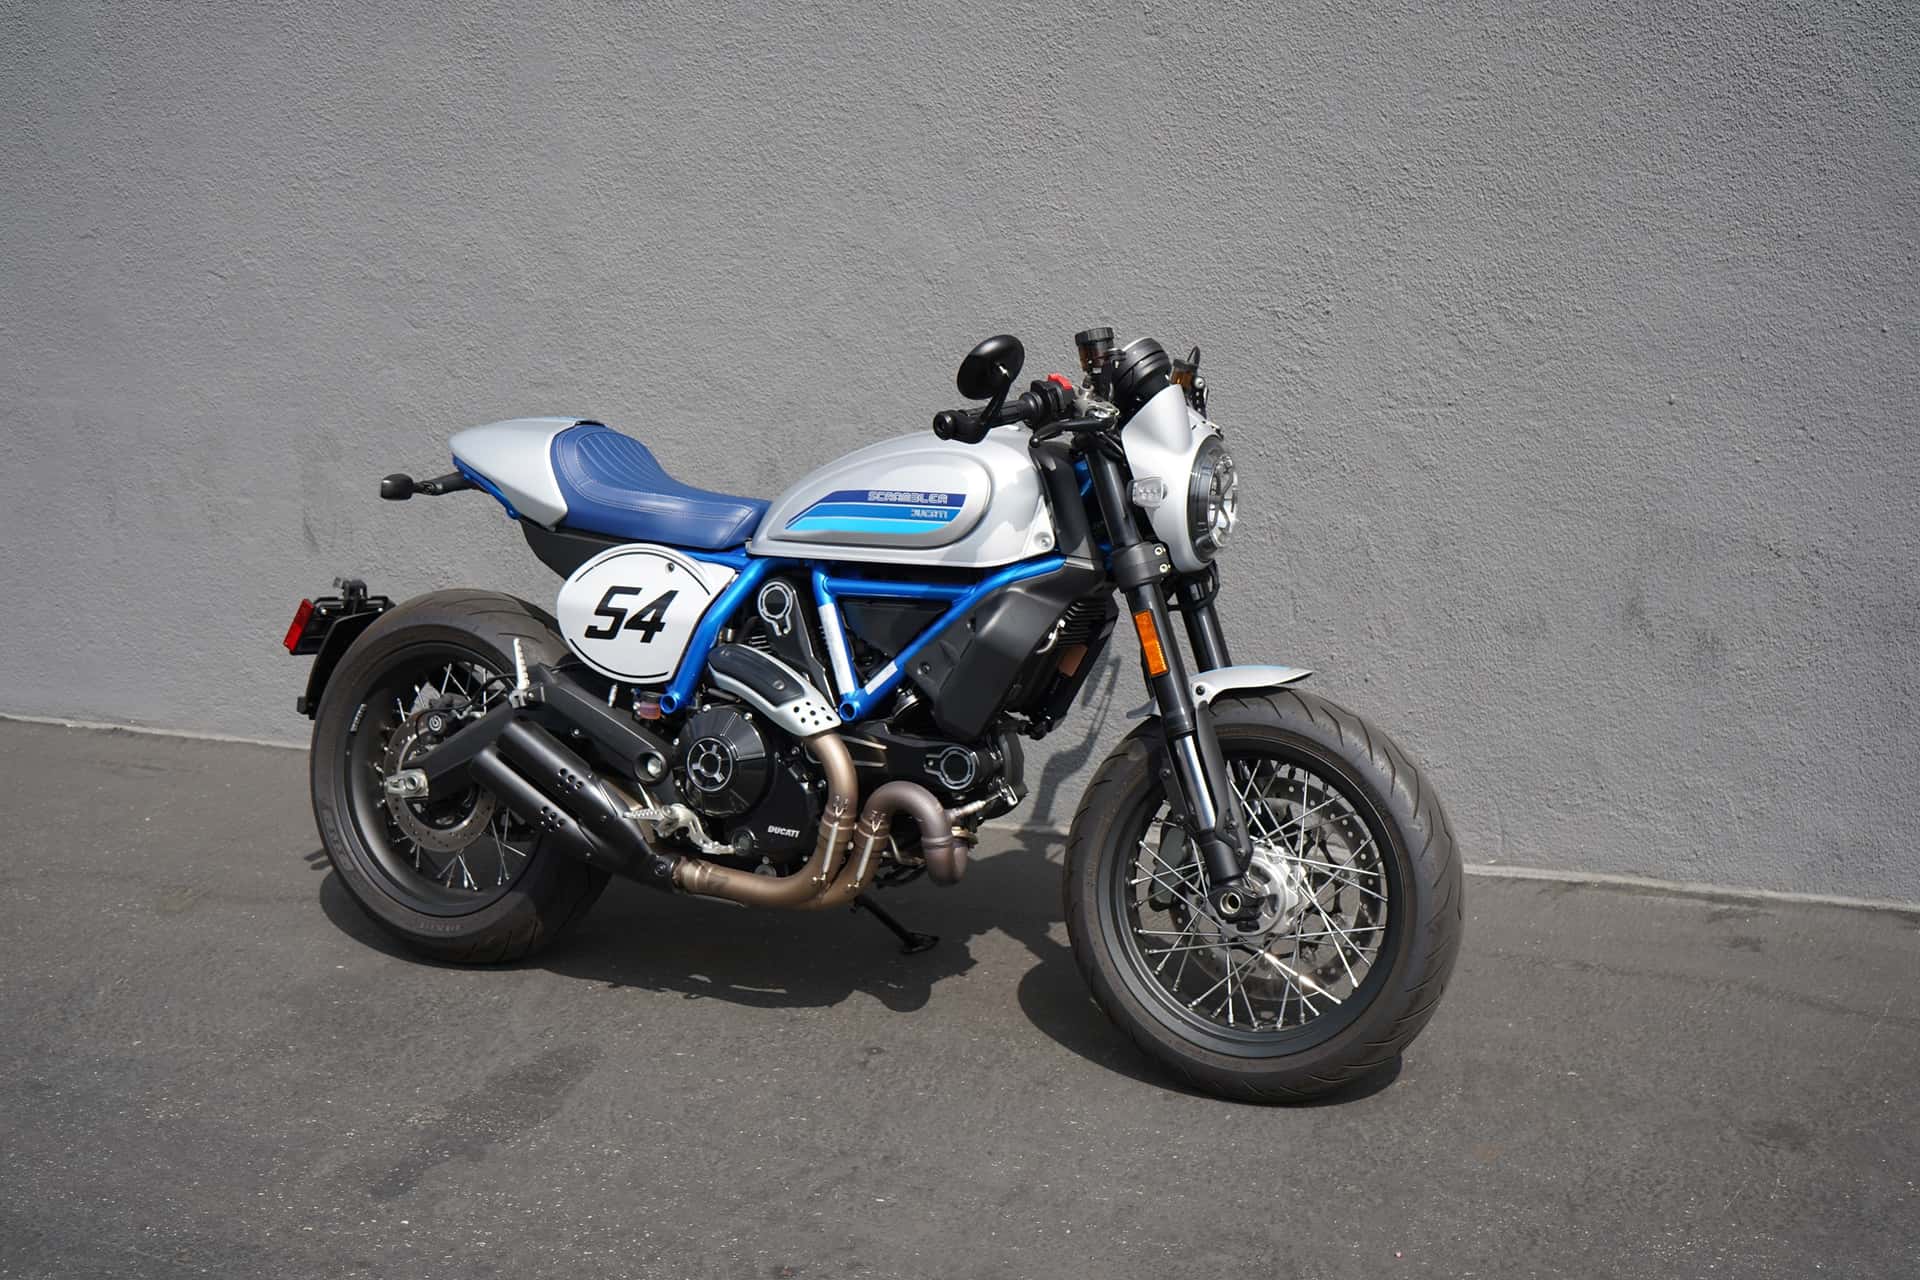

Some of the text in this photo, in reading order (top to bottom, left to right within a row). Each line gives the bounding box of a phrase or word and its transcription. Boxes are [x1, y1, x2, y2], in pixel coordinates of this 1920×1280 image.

[867, 491, 948, 505] SCRAMBLER
[911, 508, 948, 519] DUCATI
[584, 585, 679, 643] 54
[767, 825, 800, 838] DUCATI
